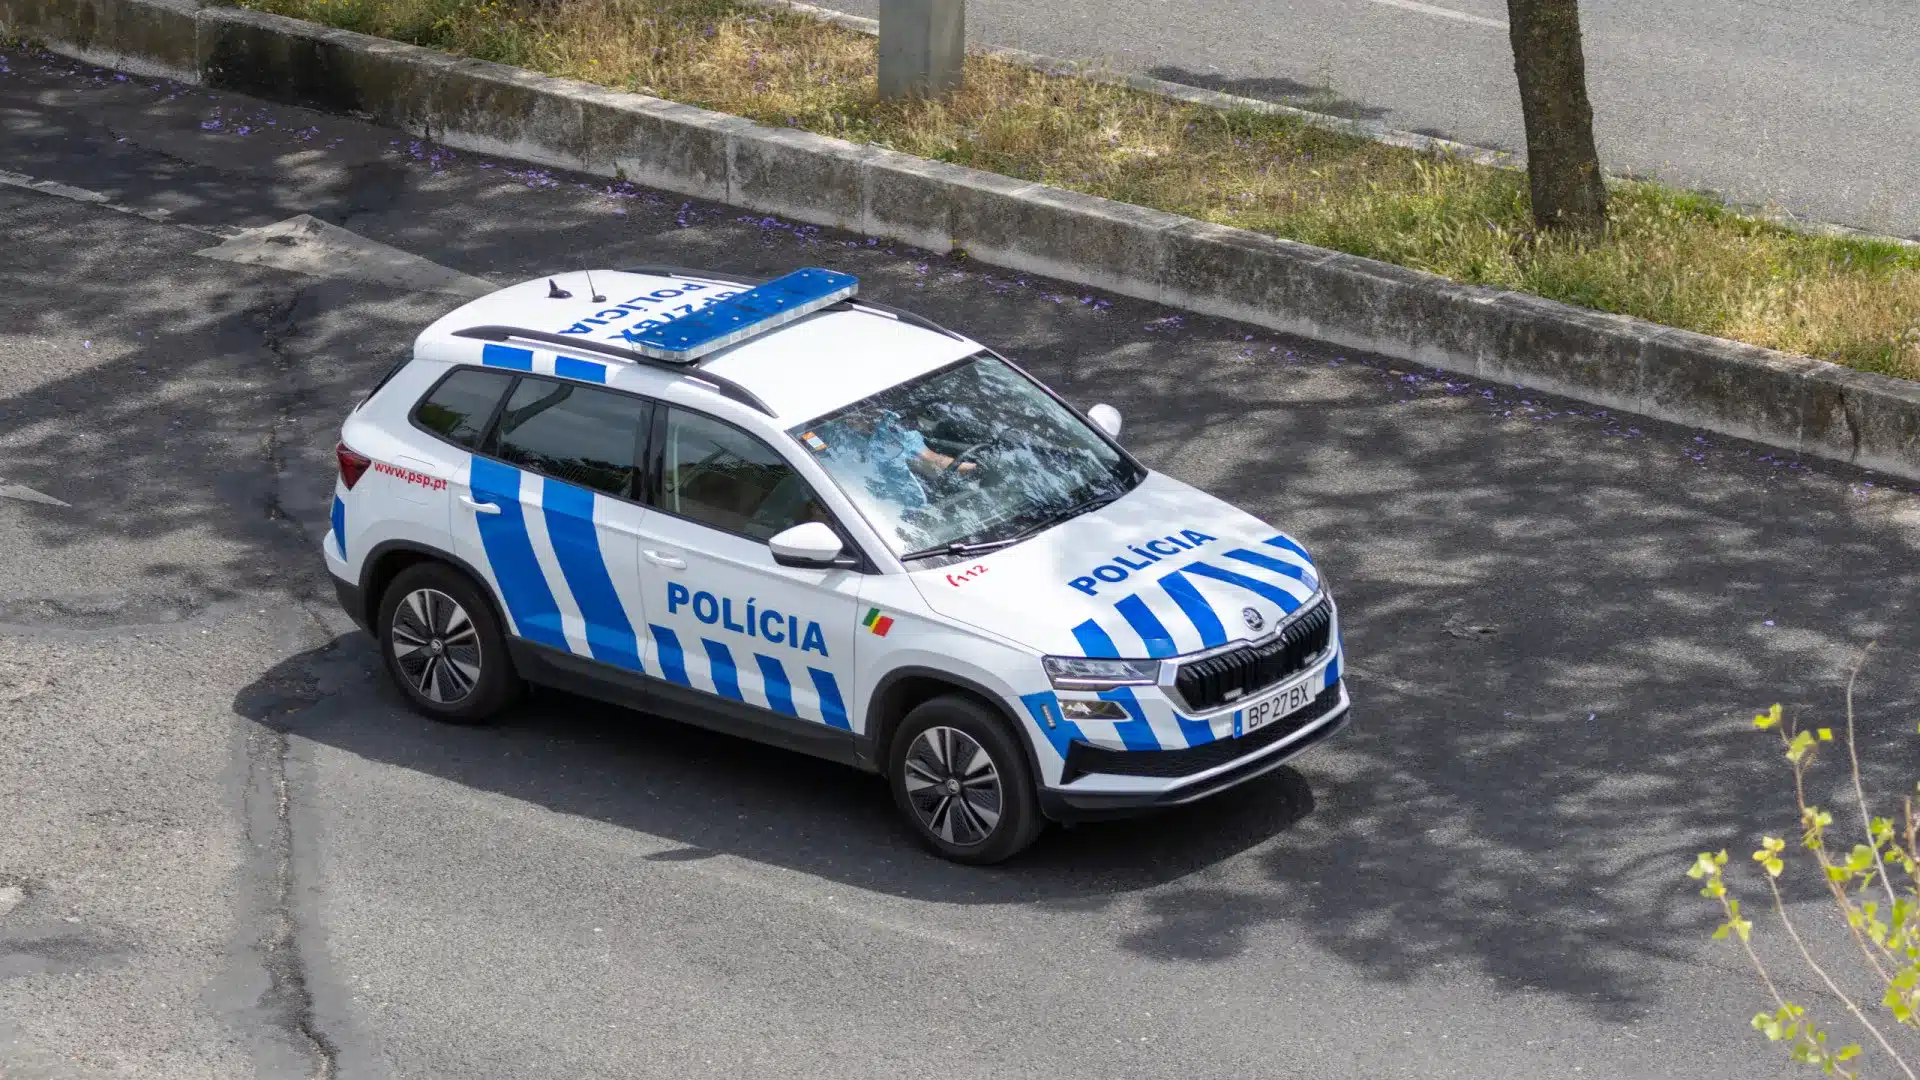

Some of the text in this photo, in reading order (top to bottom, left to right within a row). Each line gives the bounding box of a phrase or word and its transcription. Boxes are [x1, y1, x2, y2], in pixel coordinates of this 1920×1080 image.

[557, 283, 708, 334] POLÍCIA
[373, 461, 447, 490] www.psp.pt
[957, 565, 989, 581] 112
[1067, 529, 1219, 596] POLÍCIA
[667, 581, 829, 658] POLÍCIA
[1249, 682, 1309, 729] BP 27 BX
